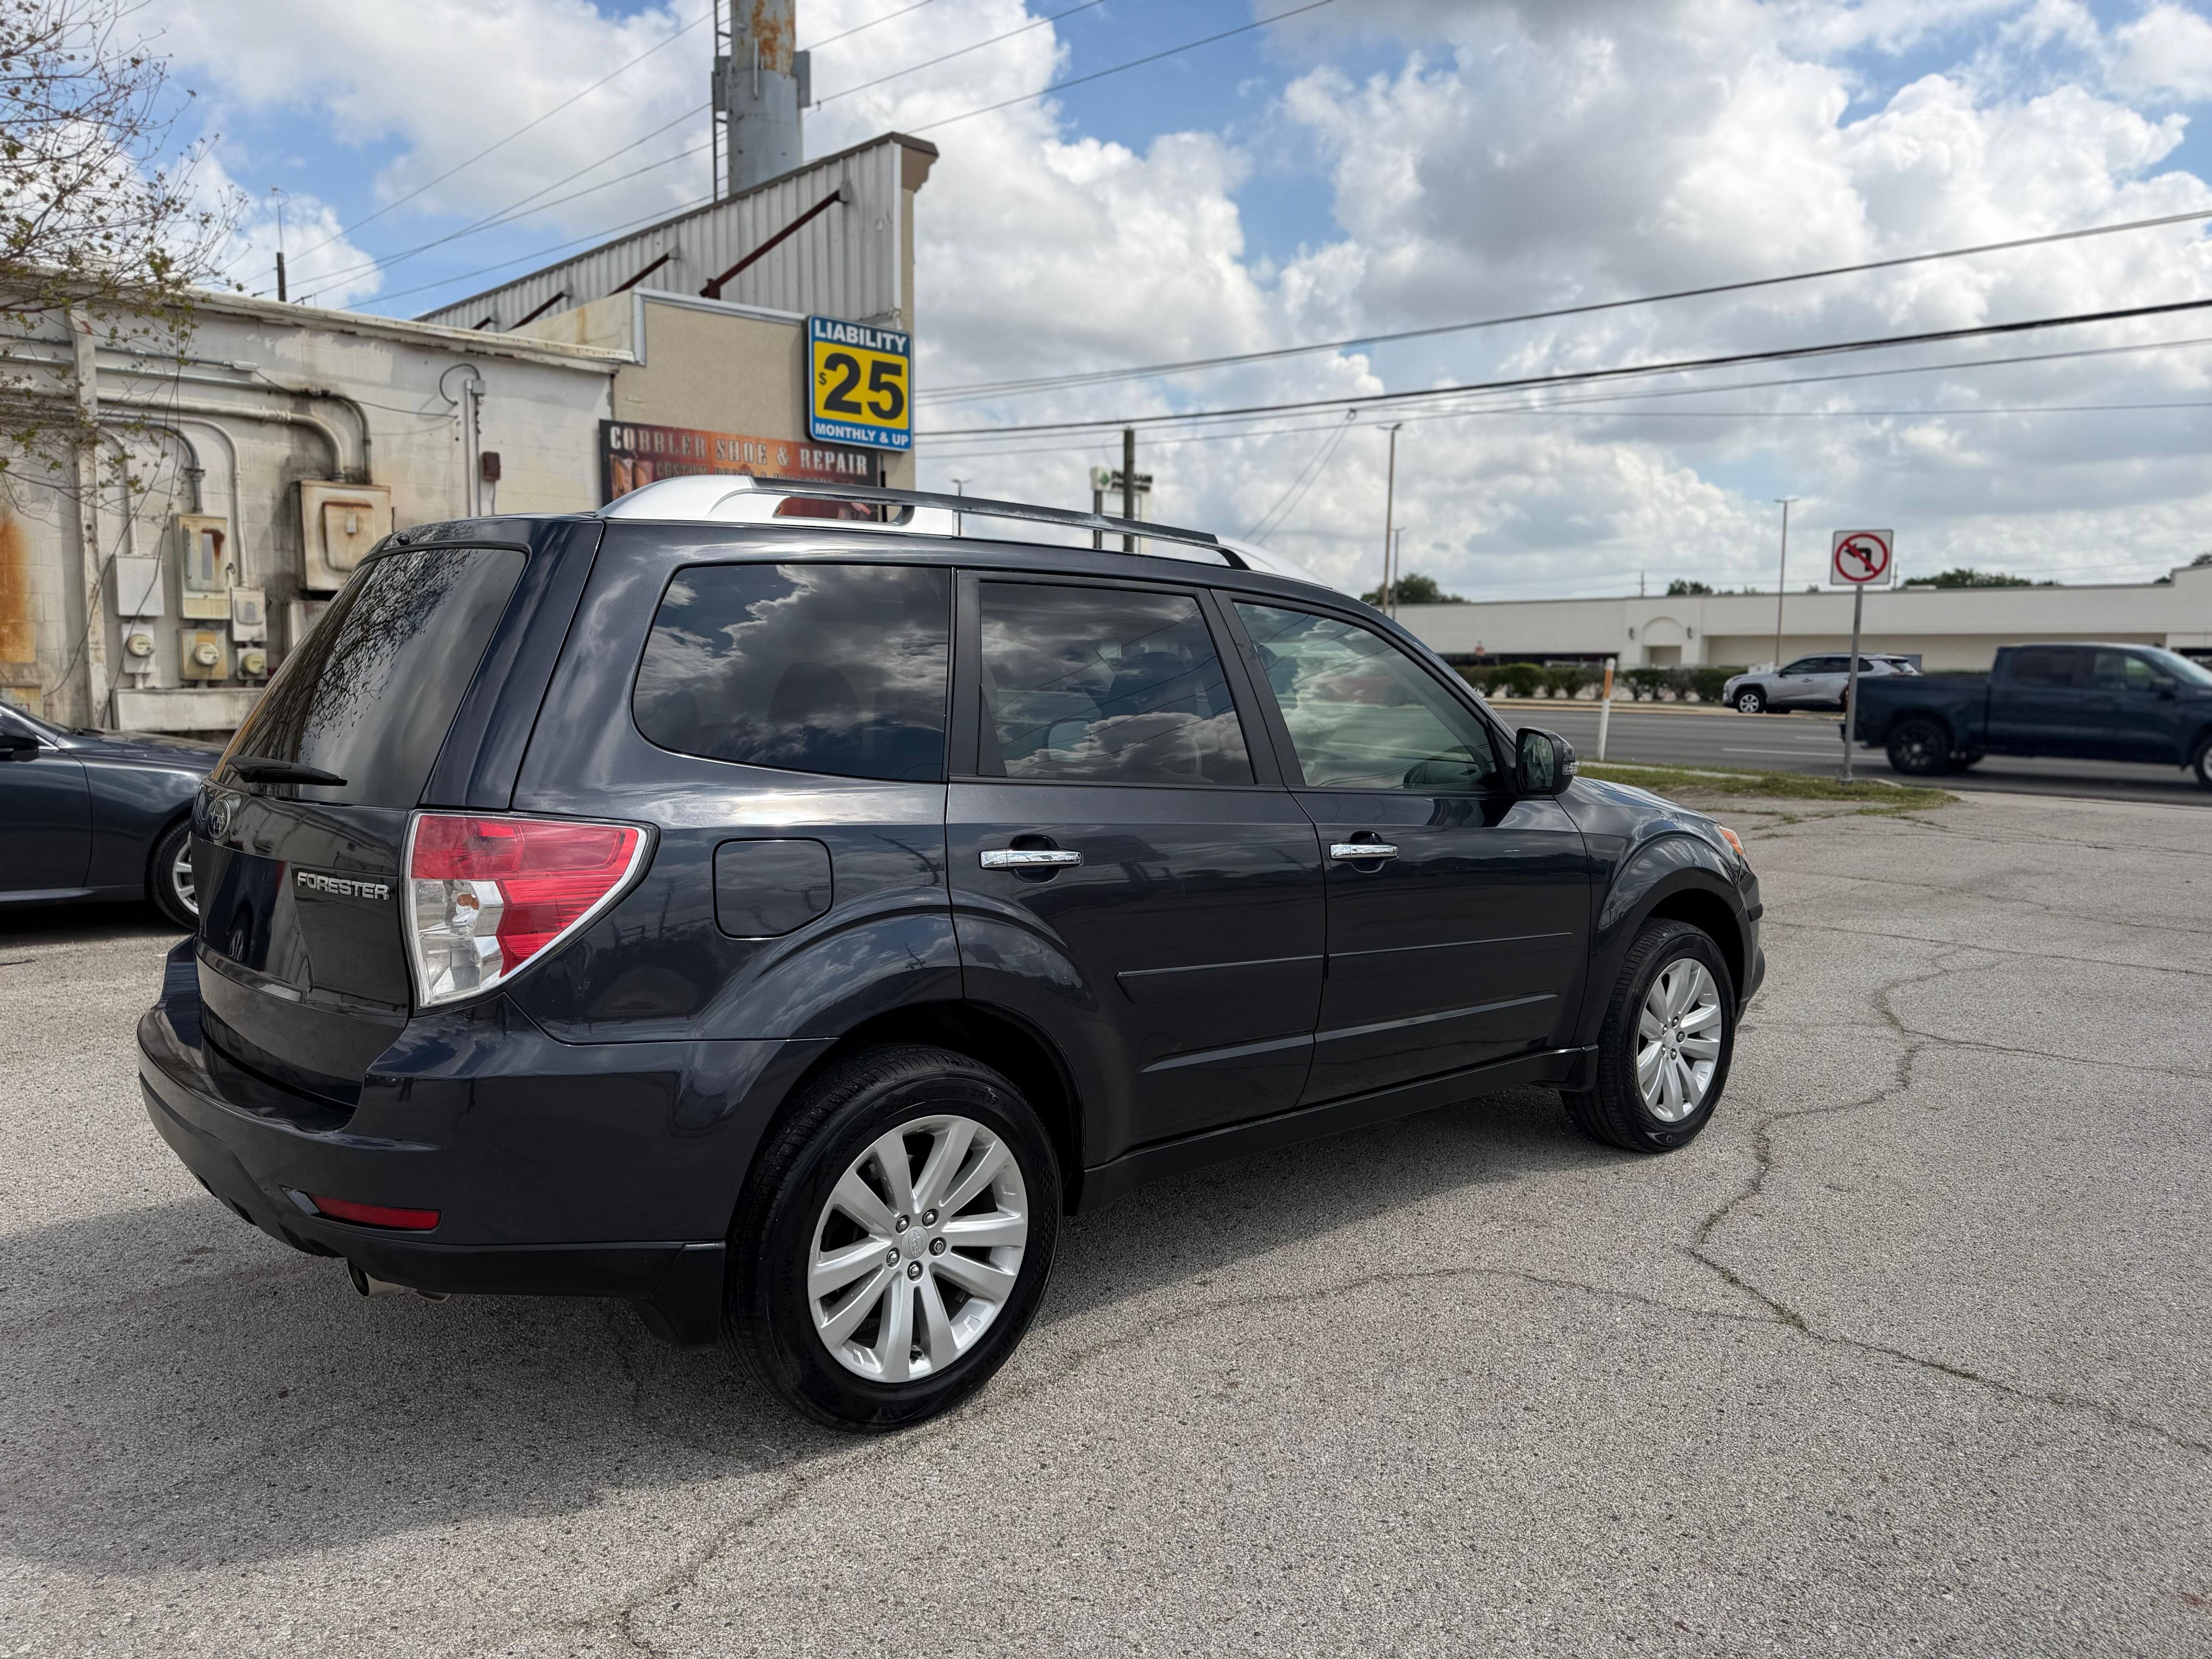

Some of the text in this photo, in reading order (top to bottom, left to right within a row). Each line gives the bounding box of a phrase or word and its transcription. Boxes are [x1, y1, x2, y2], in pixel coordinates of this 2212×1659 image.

[815, 319, 906, 352] LIABILITY
[815, 423, 909, 445] MONTHLY & UP
[610, 426, 868, 475] COBBLER SHOE & REPAIR
[298, 872, 390, 900] FORESTER
